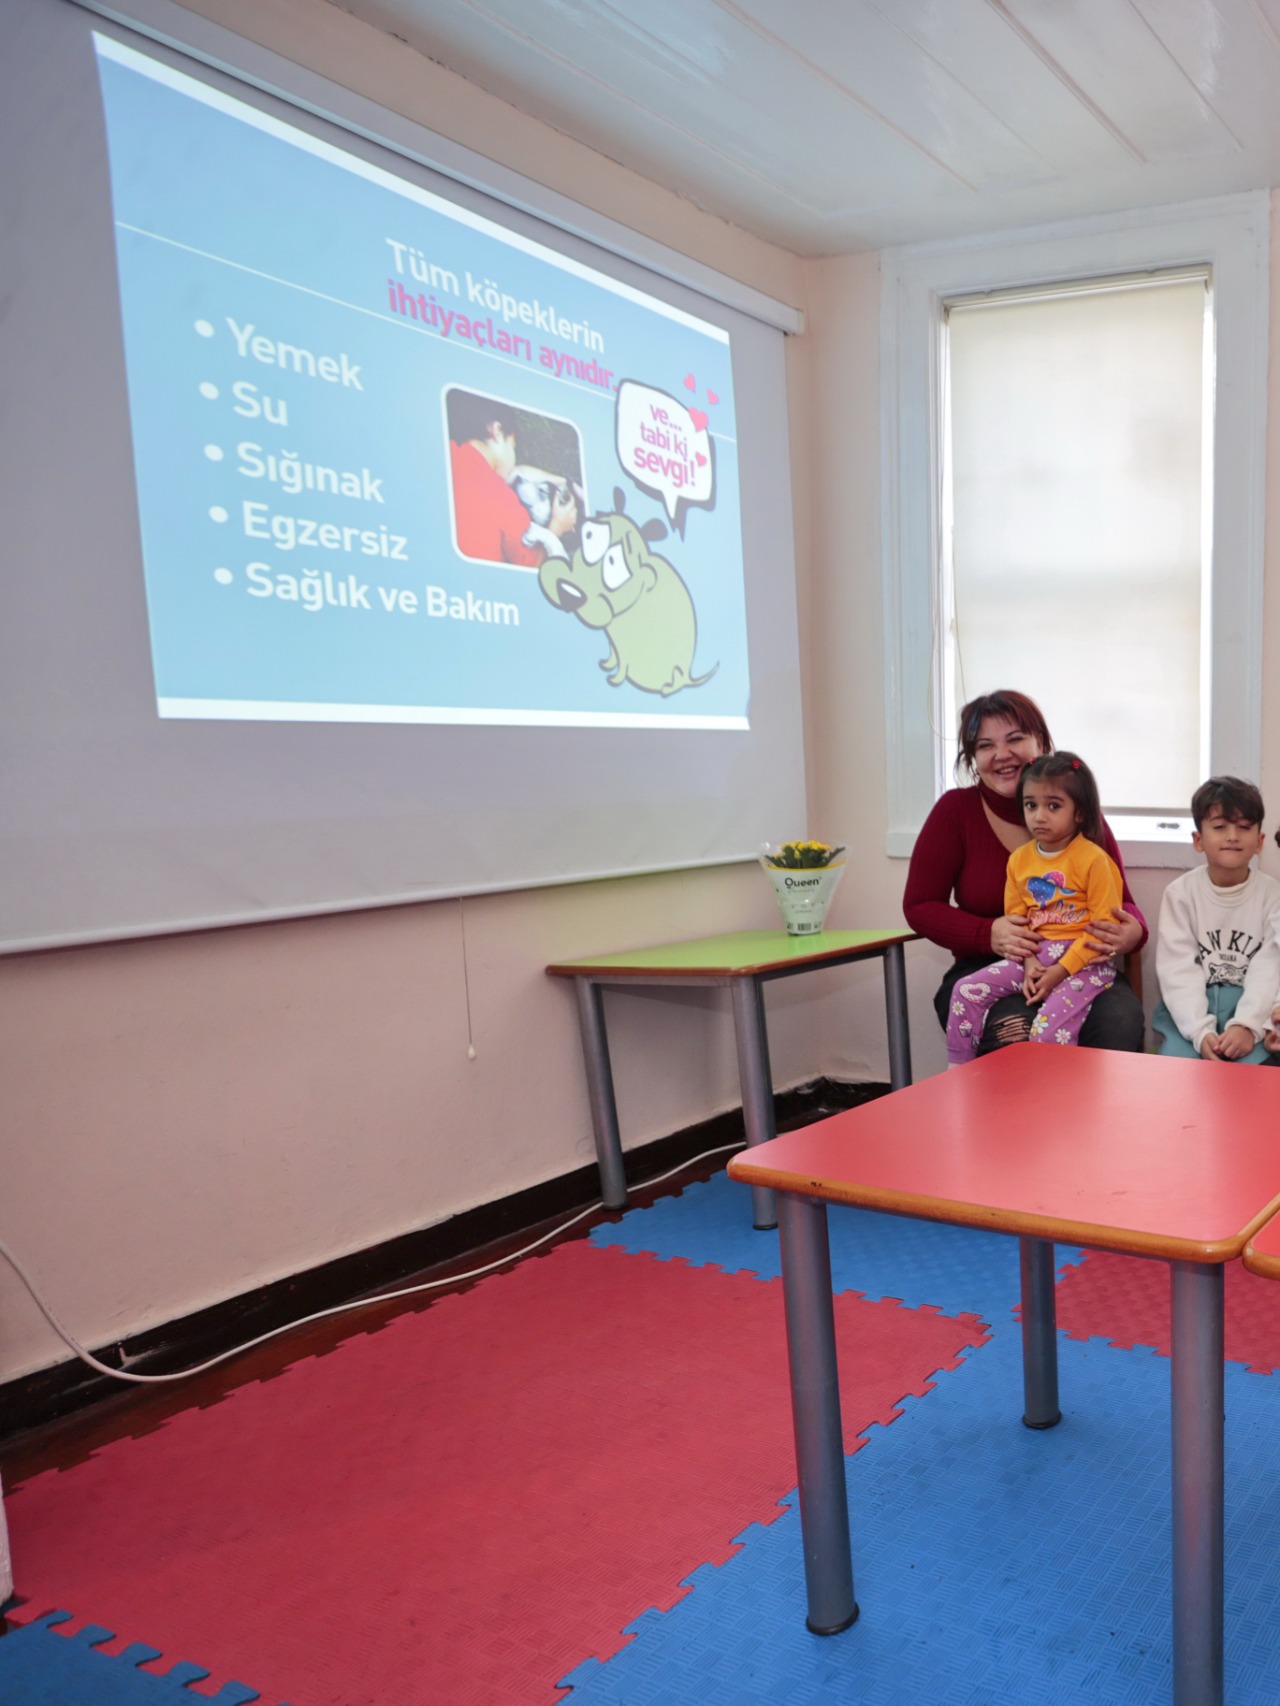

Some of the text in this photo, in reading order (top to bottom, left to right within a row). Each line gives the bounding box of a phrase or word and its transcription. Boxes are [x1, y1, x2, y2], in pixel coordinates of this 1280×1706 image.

[385, 237, 605, 354] Tüm köpeklerin
[225, 316, 365, 391] Yemek
[387, 278, 619, 392] ihtiyaçları aynıdır.
[232, 380, 288, 426] Su
[649, 403, 682, 432] ve...
[634, 446, 696, 489] sevgi!
[640, 421, 688, 459] tabi ki
[237, 441, 385, 504] Sığınak
[242, 500, 409, 561] Egzersiz
[245, 561, 520, 626] Sağlık ve Bakım
[784, 877, 819, 889] Queen
